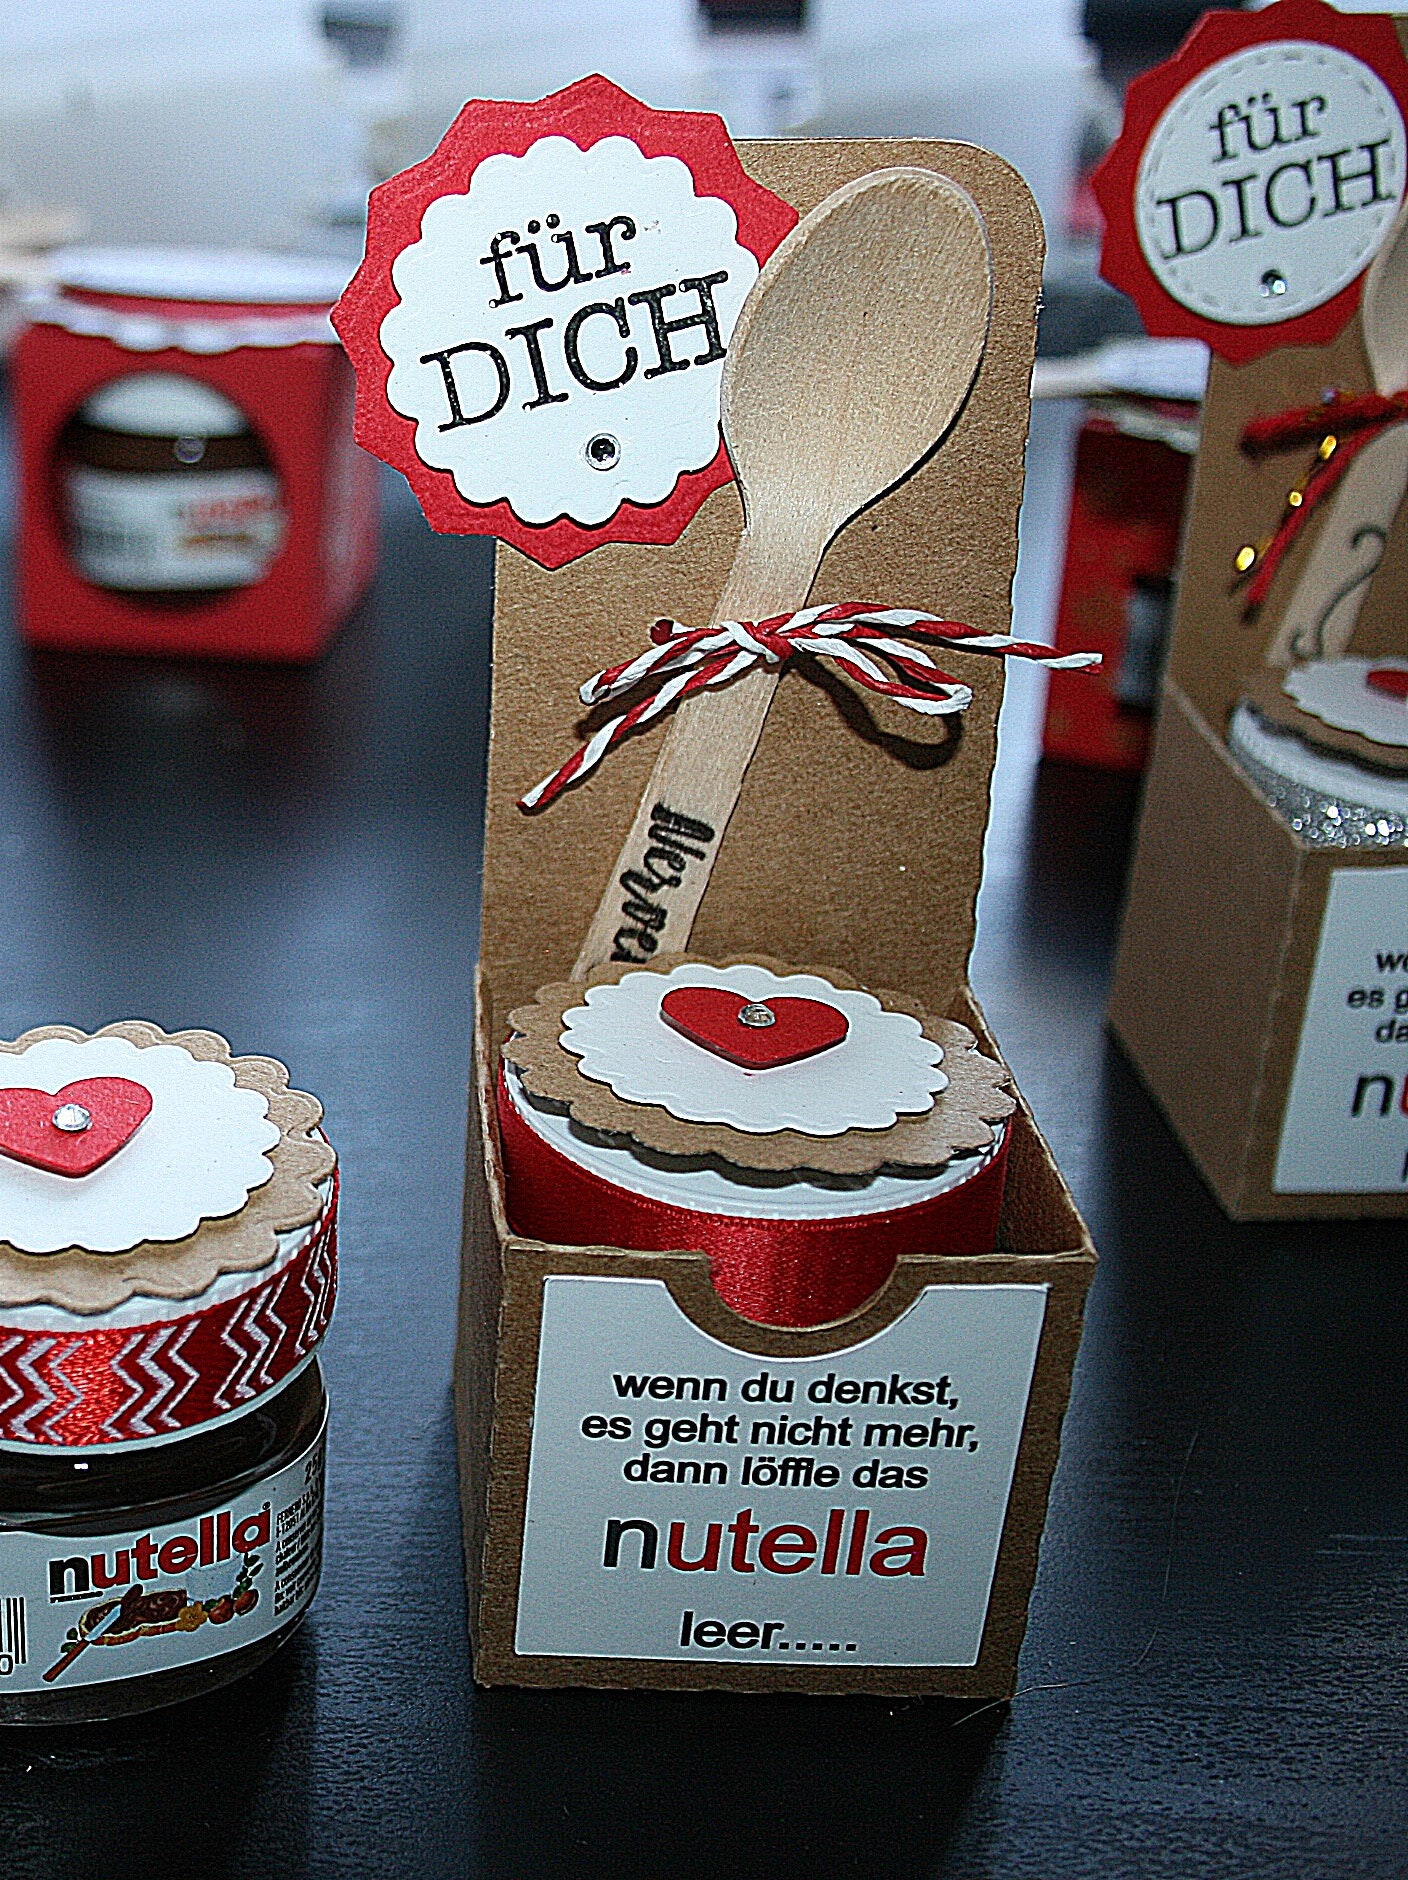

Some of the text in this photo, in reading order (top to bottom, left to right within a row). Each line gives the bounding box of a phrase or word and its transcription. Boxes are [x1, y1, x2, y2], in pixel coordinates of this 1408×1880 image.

[1210, 92, 1327, 163] für
[1156, 135, 1397, 260] DICH
[480, 213, 636, 307] für
[420, 271, 728, 431] DICH
[1347, 987, 1385, 1009] es
[612, 1372, 959, 1410] wenn du denkst,
[581, 1413, 980, 1452] es geht nicht mehr,
[623, 1454, 928, 1490] dann löffle das
[48, 1509, 271, 1596] nutella
[603, 1507, 928, 1578] nutella
[679, 1611, 858, 1653] leer.....
